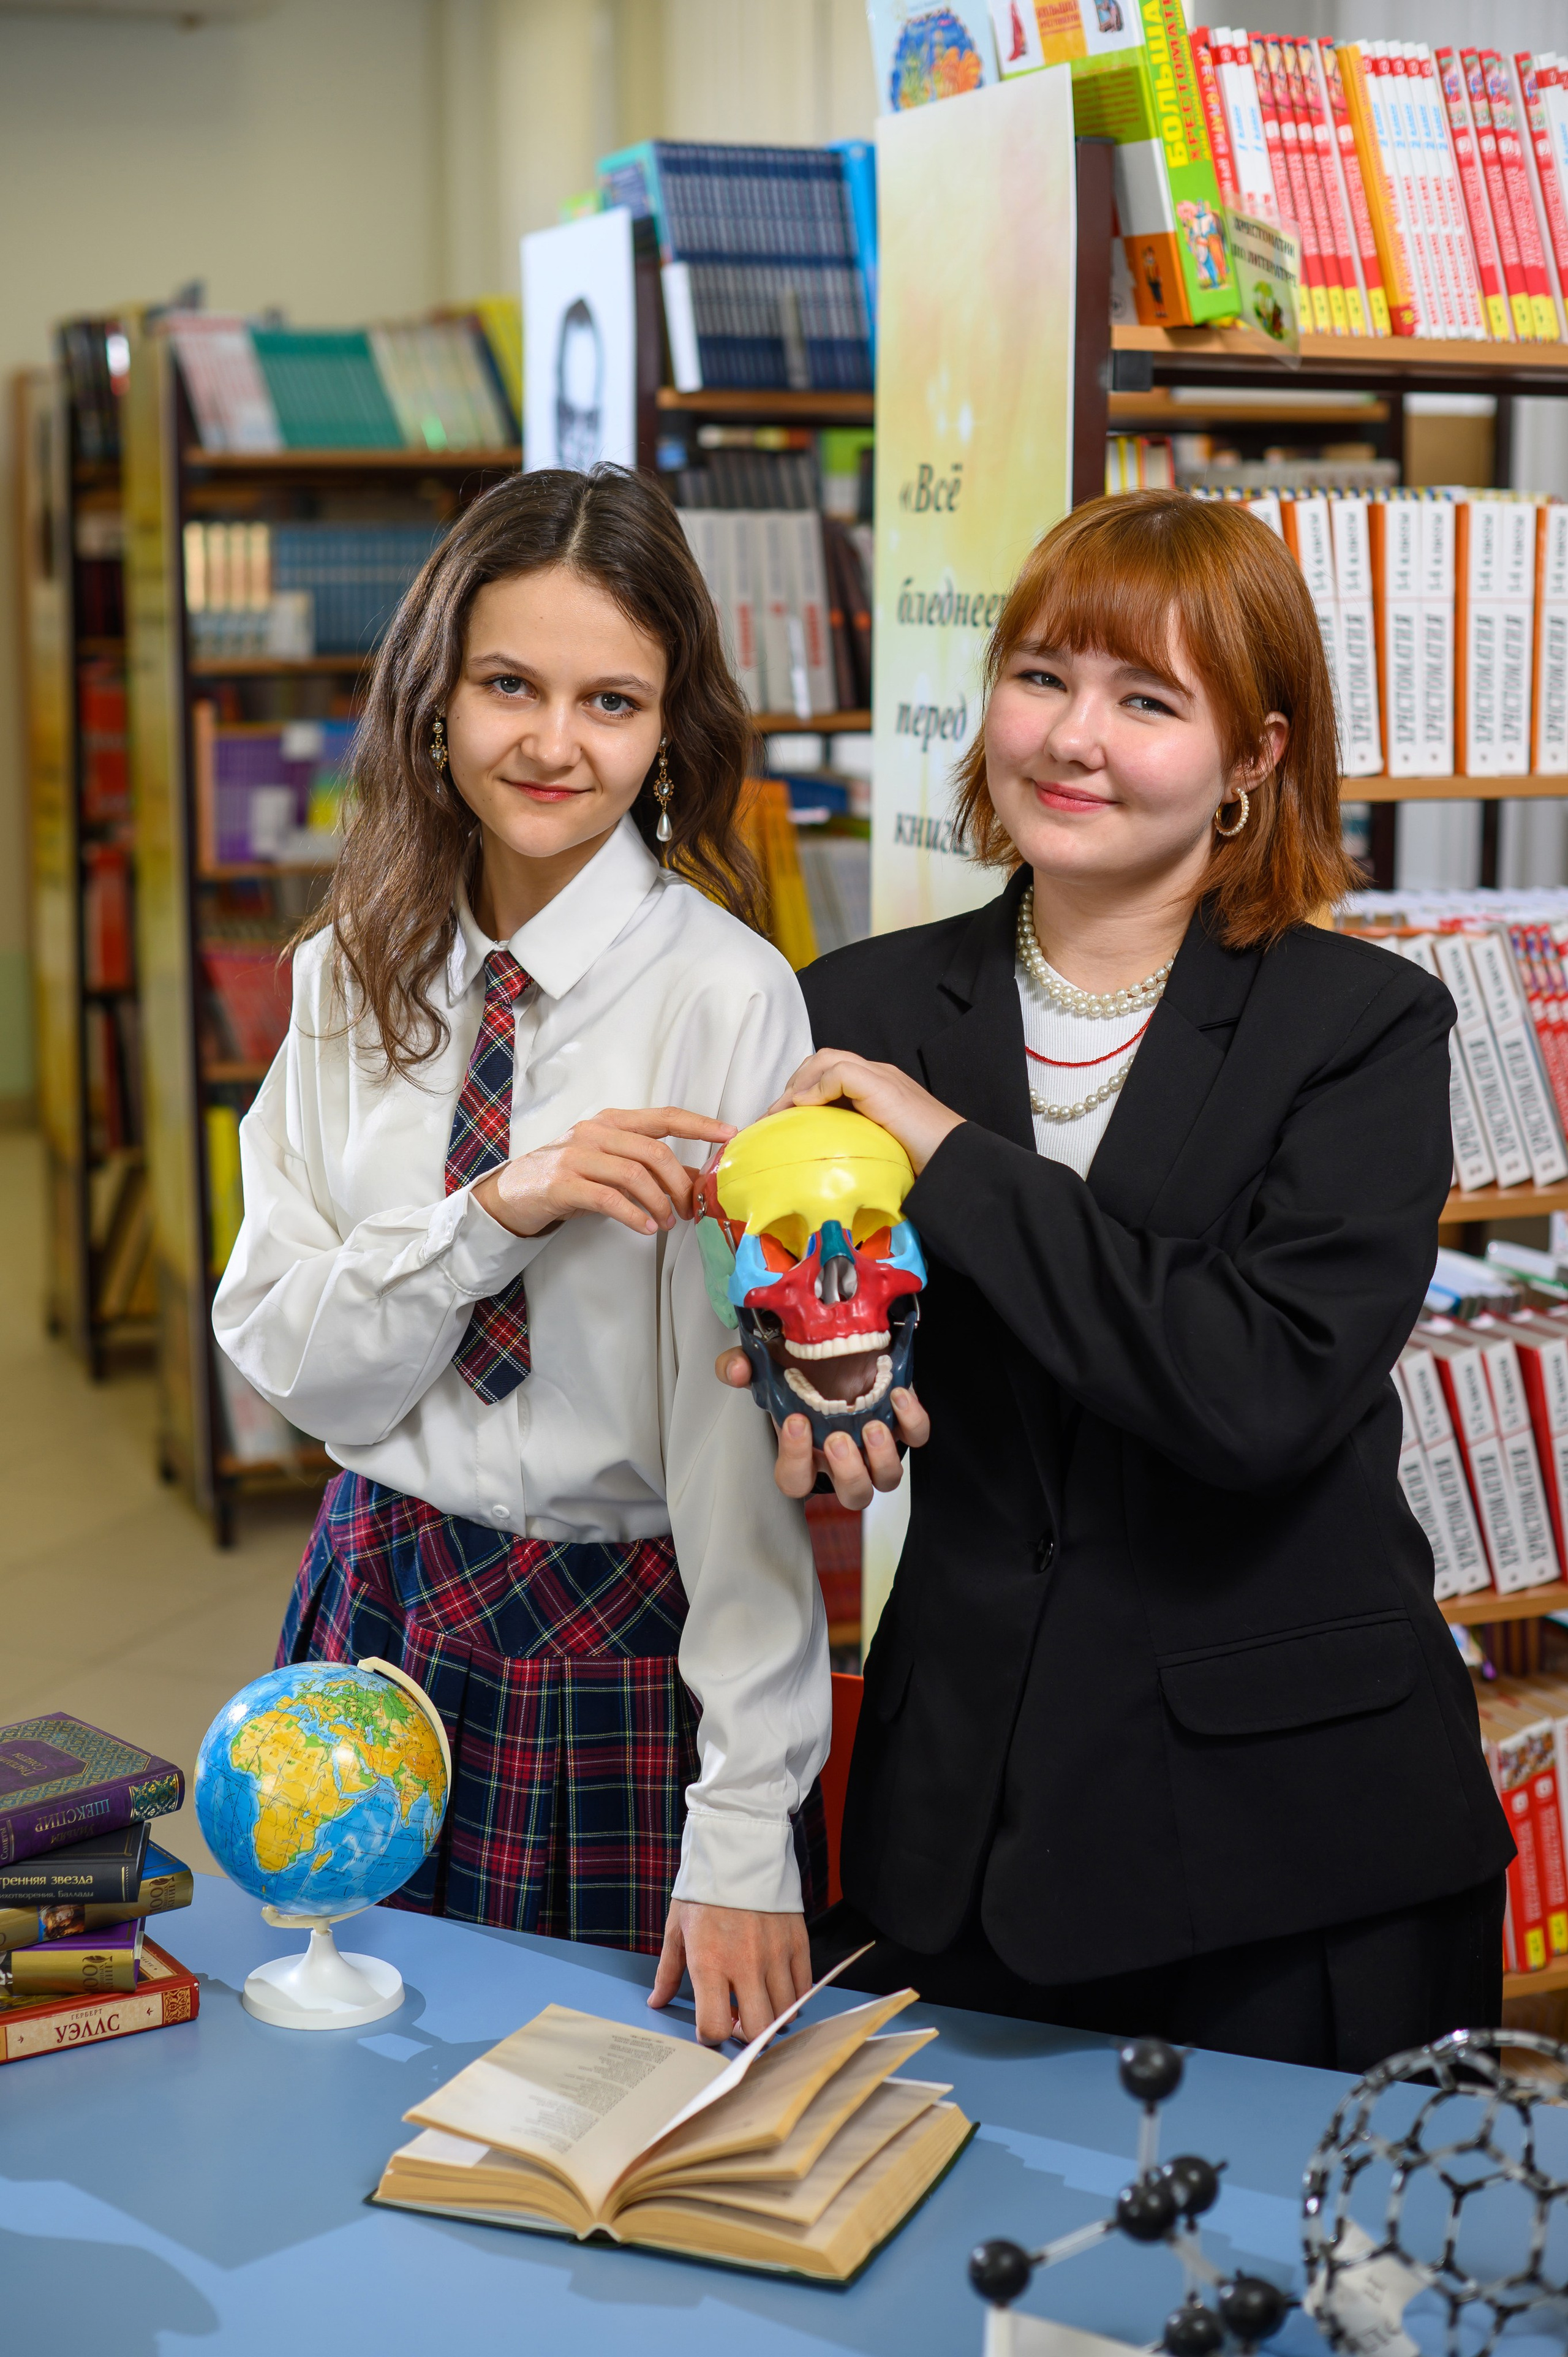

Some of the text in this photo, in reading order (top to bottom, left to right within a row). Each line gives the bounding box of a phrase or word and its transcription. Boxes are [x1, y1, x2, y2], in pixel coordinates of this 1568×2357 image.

[899, 462, 963, 513] «Всё
[895, 692, 968, 753] перед
[35, 1798, 110, 1833] ШЕКСПИР
[51, 1875, 93, 1885] звезда
[54, 2013, 120, 2043] УЭЛЛС
[71, 2008, 102, 2020] ГЕРБЕРТ
